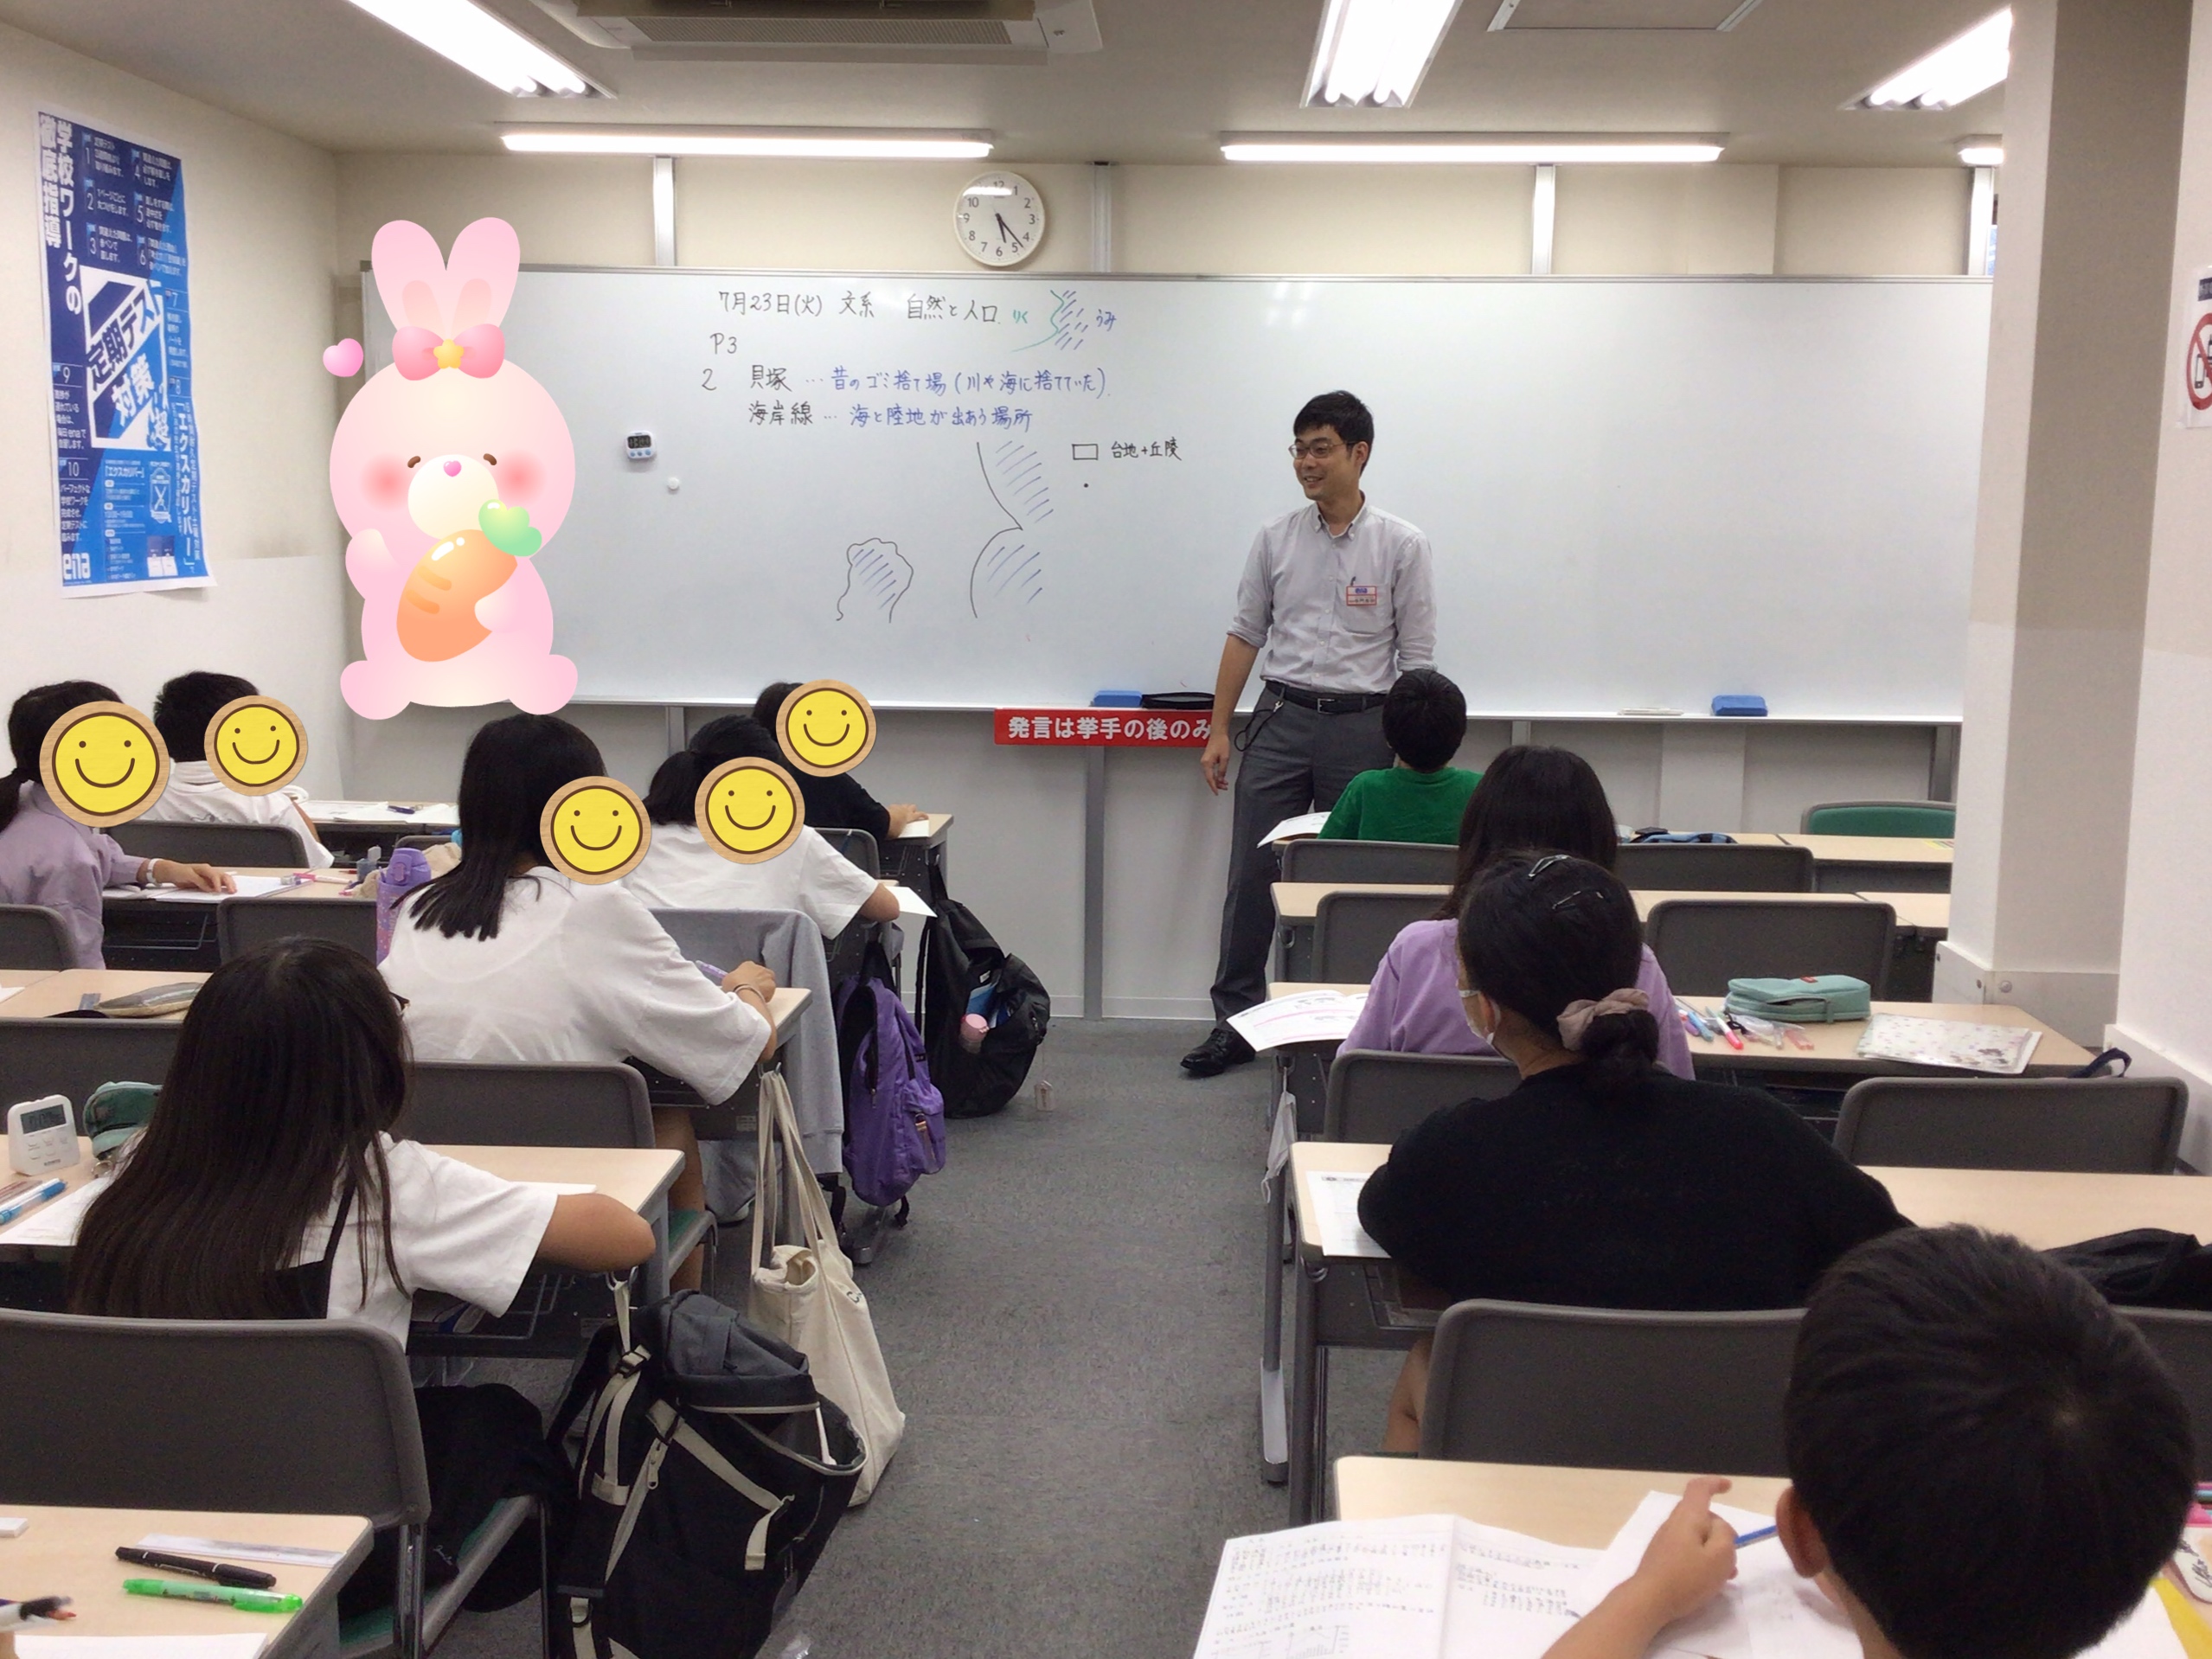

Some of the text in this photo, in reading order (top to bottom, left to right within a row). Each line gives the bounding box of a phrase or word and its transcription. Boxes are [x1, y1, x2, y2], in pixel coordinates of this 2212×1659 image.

[40, 113, 61, 248] 徹底指導
[134, 164, 141, 181] 4
[87, 193, 93, 210] 2
[967, 196, 979, 208] 10
[1024, 197, 1031, 208] 2
[57, 119, 81, 315] 学校ワークの
[137, 205, 144, 223] 5
[963, 213, 970, 223] 9
[1029, 214, 1035, 225] 3
[969, 230, 976, 241] 8
[1023, 232, 1029, 241] 4
[90, 238, 96, 254] 3
[981, 242, 987, 253] 7
[996, 247, 1003, 257] 6
[1012, 242, 1018, 253] 5
[140, 249, 146, 266] 6
[172, 291, 178, 307] 7
[719, 291, 997, 323] 7月23日(火) 文系 自然と人口
[1012, 309, 1029, 324] りく
[1096, 309, 1117, 331] うみ
[63, 367, 70, 383] 9
[702, 368, 717, 390] 2
[750, 365, 792, 392] 貝塚
[176, 379, 181, 394] 8
[748, 400, 813, 426] 海岸線
[850, 403, 1033, 432] 海と陸地が出あう場所
[68, 461, 80, 477] 10
[62, 552, 91, 580] ena
[1009, 716, 1211, 740] 発言は挙手の後のみ
